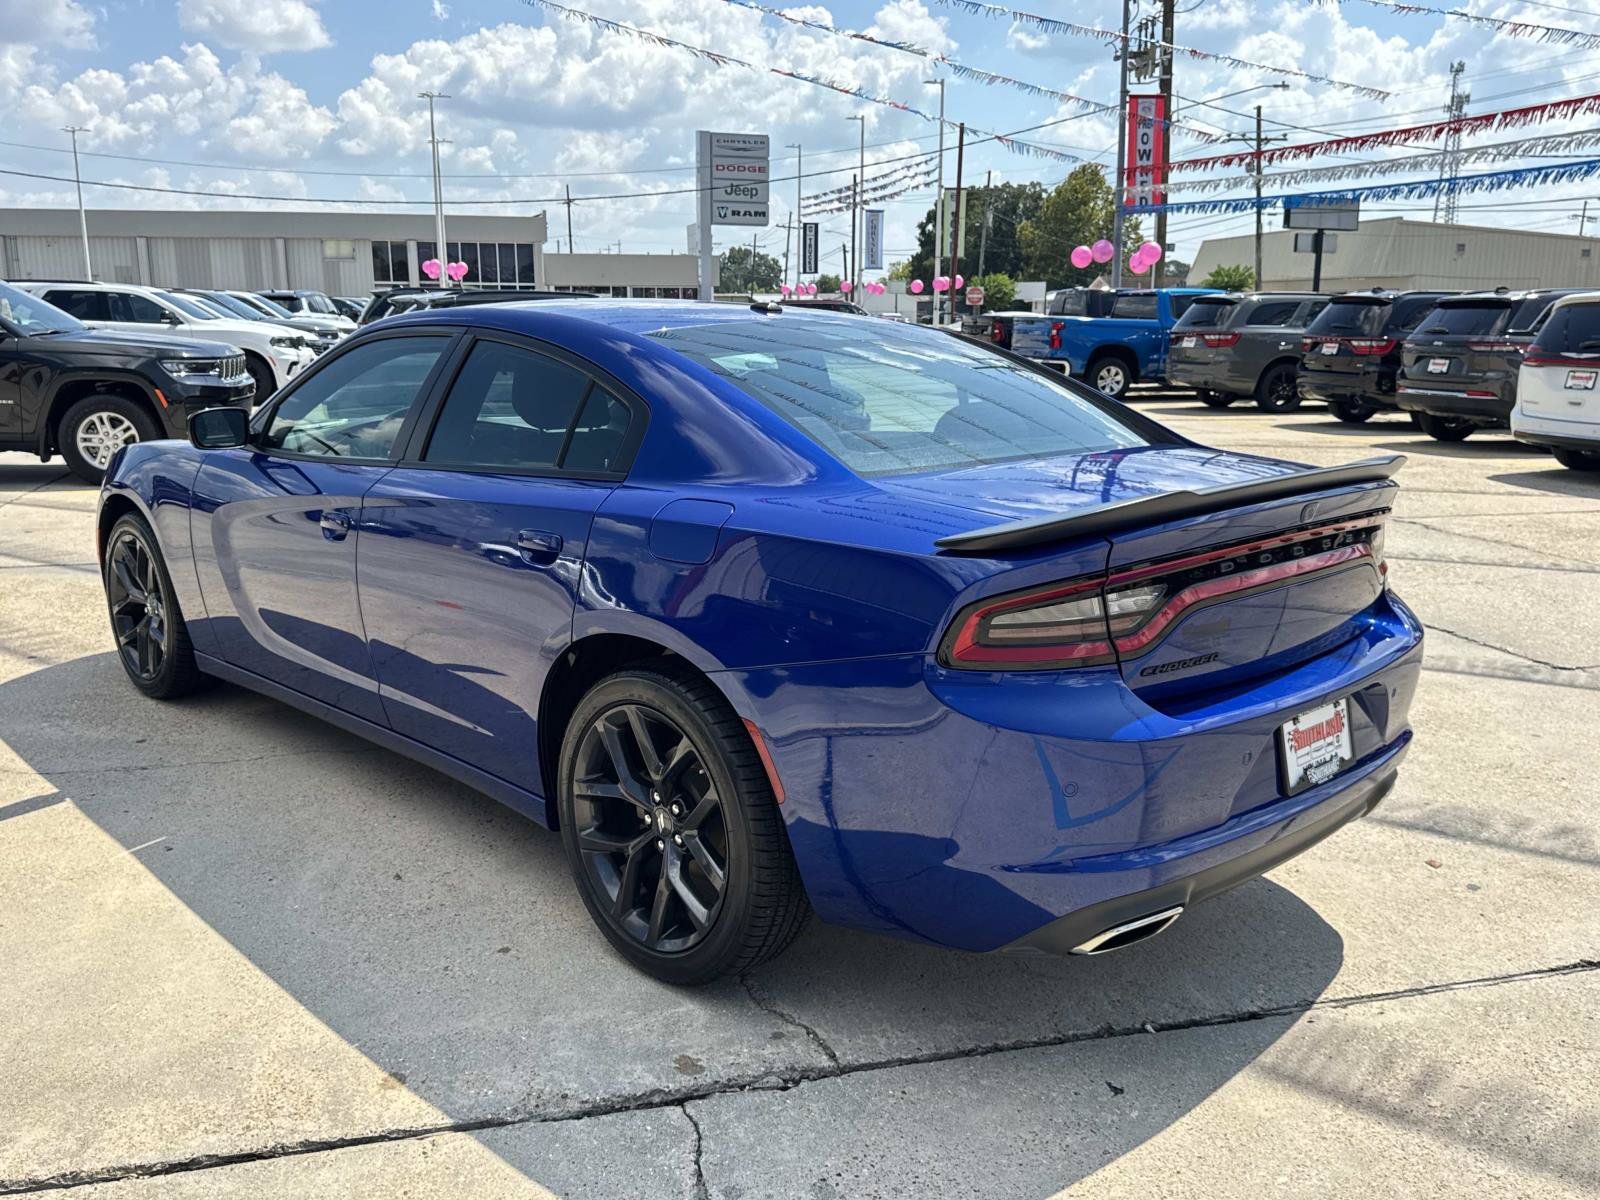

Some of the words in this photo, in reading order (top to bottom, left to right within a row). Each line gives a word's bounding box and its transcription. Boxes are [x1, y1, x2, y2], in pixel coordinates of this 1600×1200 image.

[715, 164, 768, 173] DODGE
[724, 182, 759, 199] Jeep
[731, 209, 767, 218] RAM
[1219, 533, 1355, 573] DODGE
[1140, 652, 1220, 677] CHARGER
